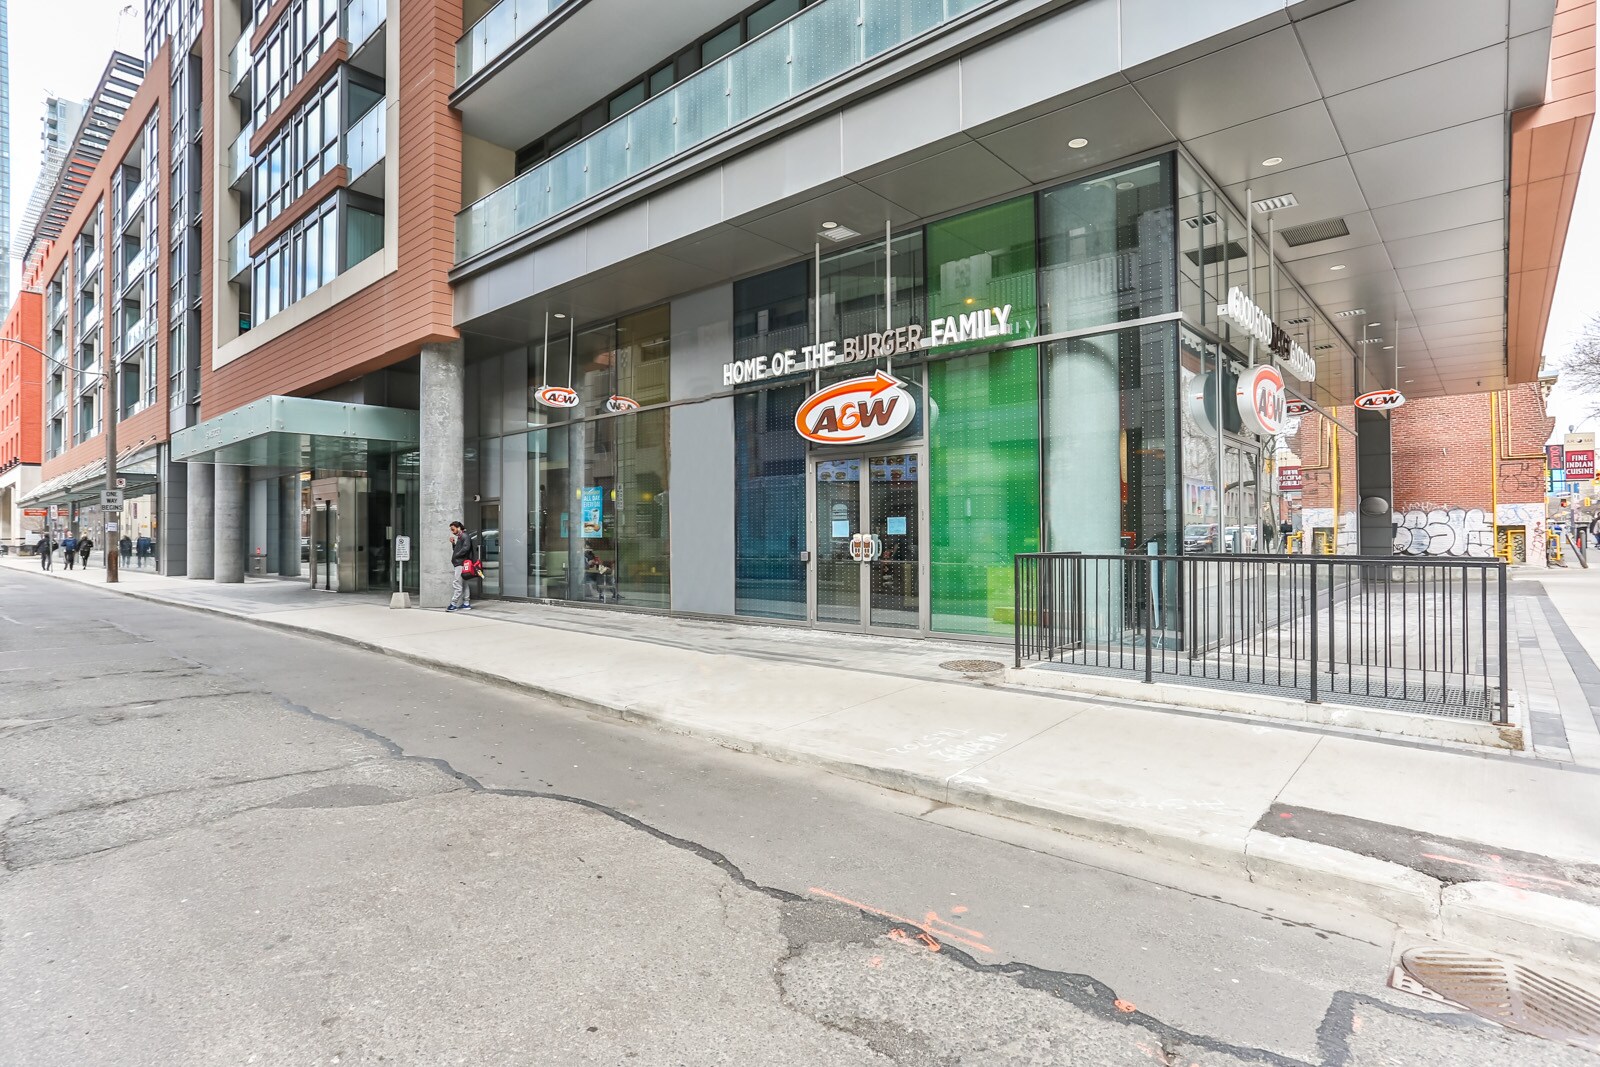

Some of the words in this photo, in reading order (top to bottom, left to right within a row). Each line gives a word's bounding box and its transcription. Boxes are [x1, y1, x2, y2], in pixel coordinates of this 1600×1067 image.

[722, 355, 768, 386] HOME
[771, 350, 797, 376] OF
[801, 341, 836, 370] THE
[843, 324, 923, 363] BURGER
[931, 304, 1013, 347] FAMILY
[547, 393, 577, 405] A&W
[810, 395, 900, 435] A&W
[1258, 387, 1284, 424] A&W
[1362, 395, 1400, 407] A&W
